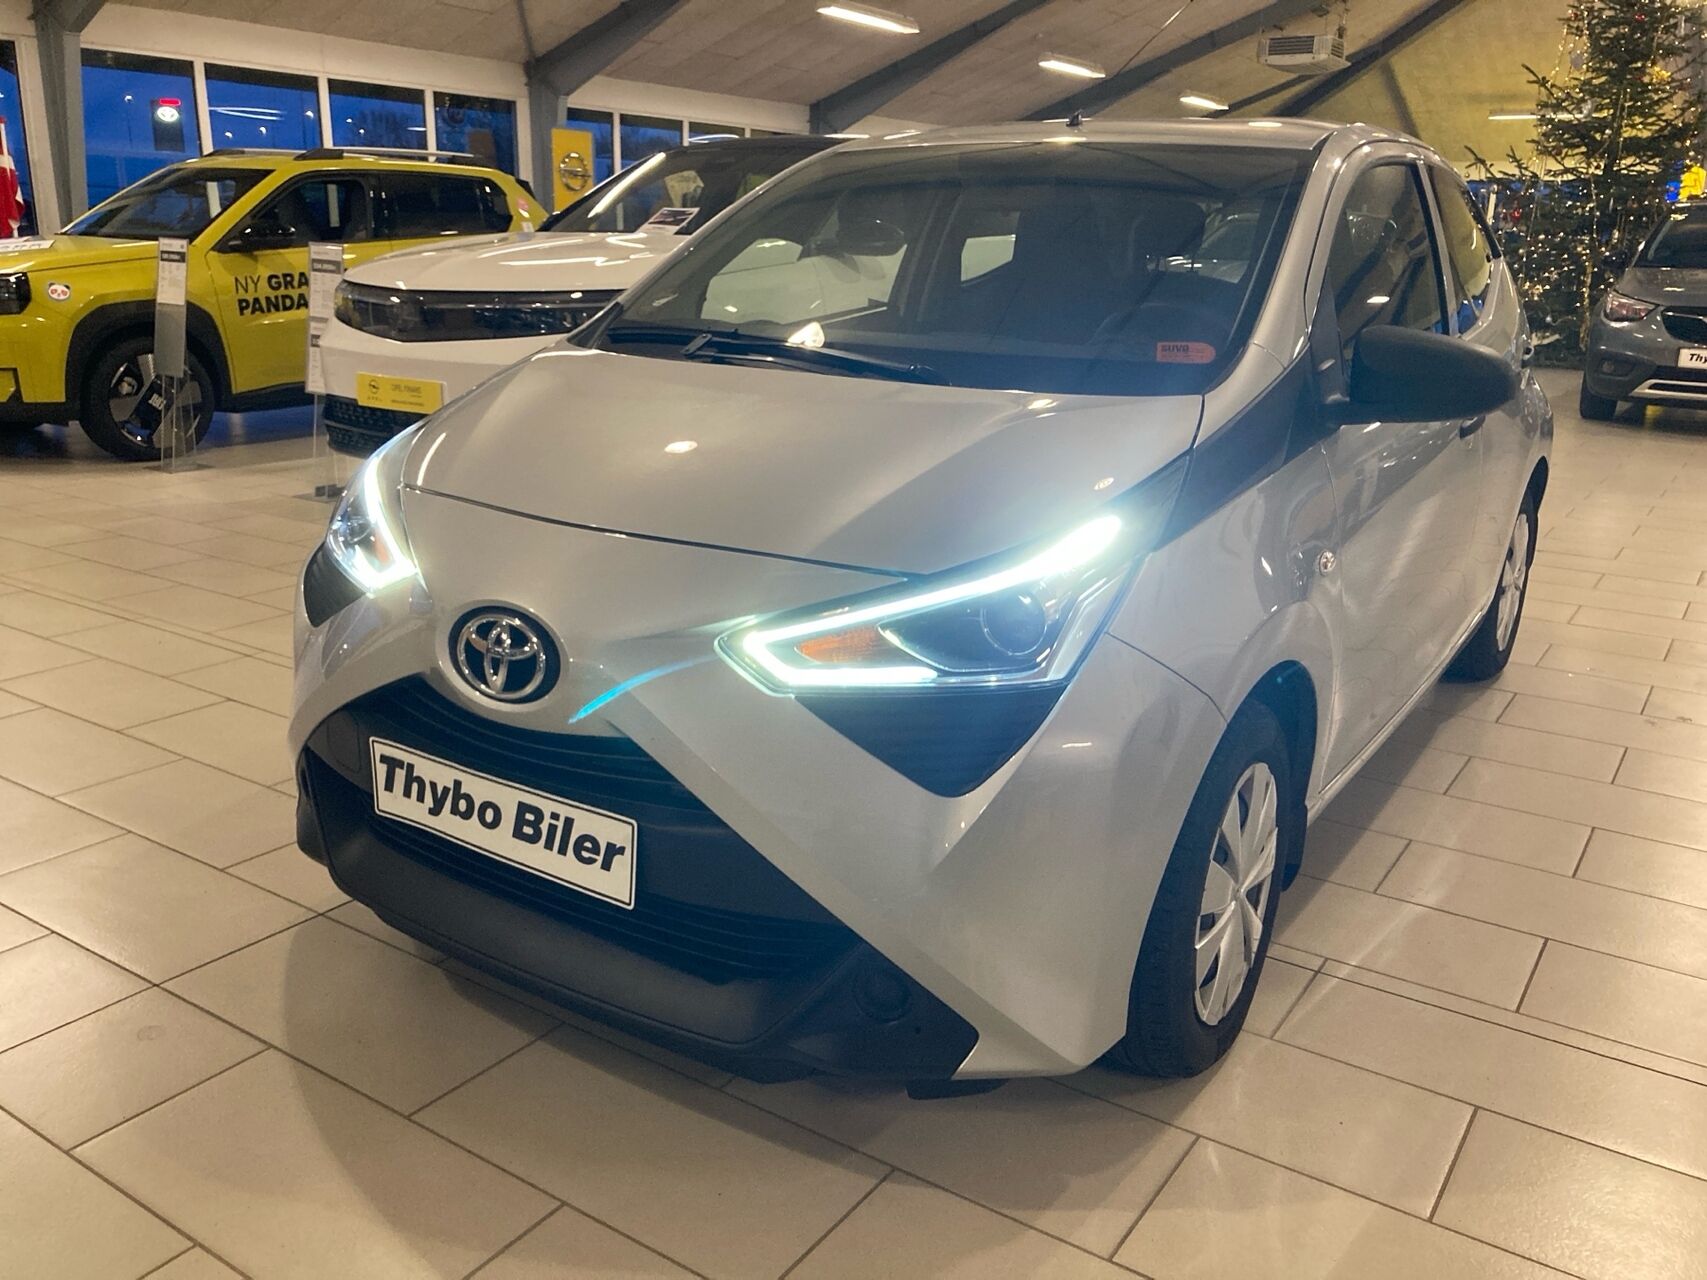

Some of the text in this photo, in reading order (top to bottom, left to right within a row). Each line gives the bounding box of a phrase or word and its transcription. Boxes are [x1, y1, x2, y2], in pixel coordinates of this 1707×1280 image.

[234, 275, 260, 294] NY
[237, 293, 308, 316] PANDA
[379, 753, 626, 872] Thybo Biler
